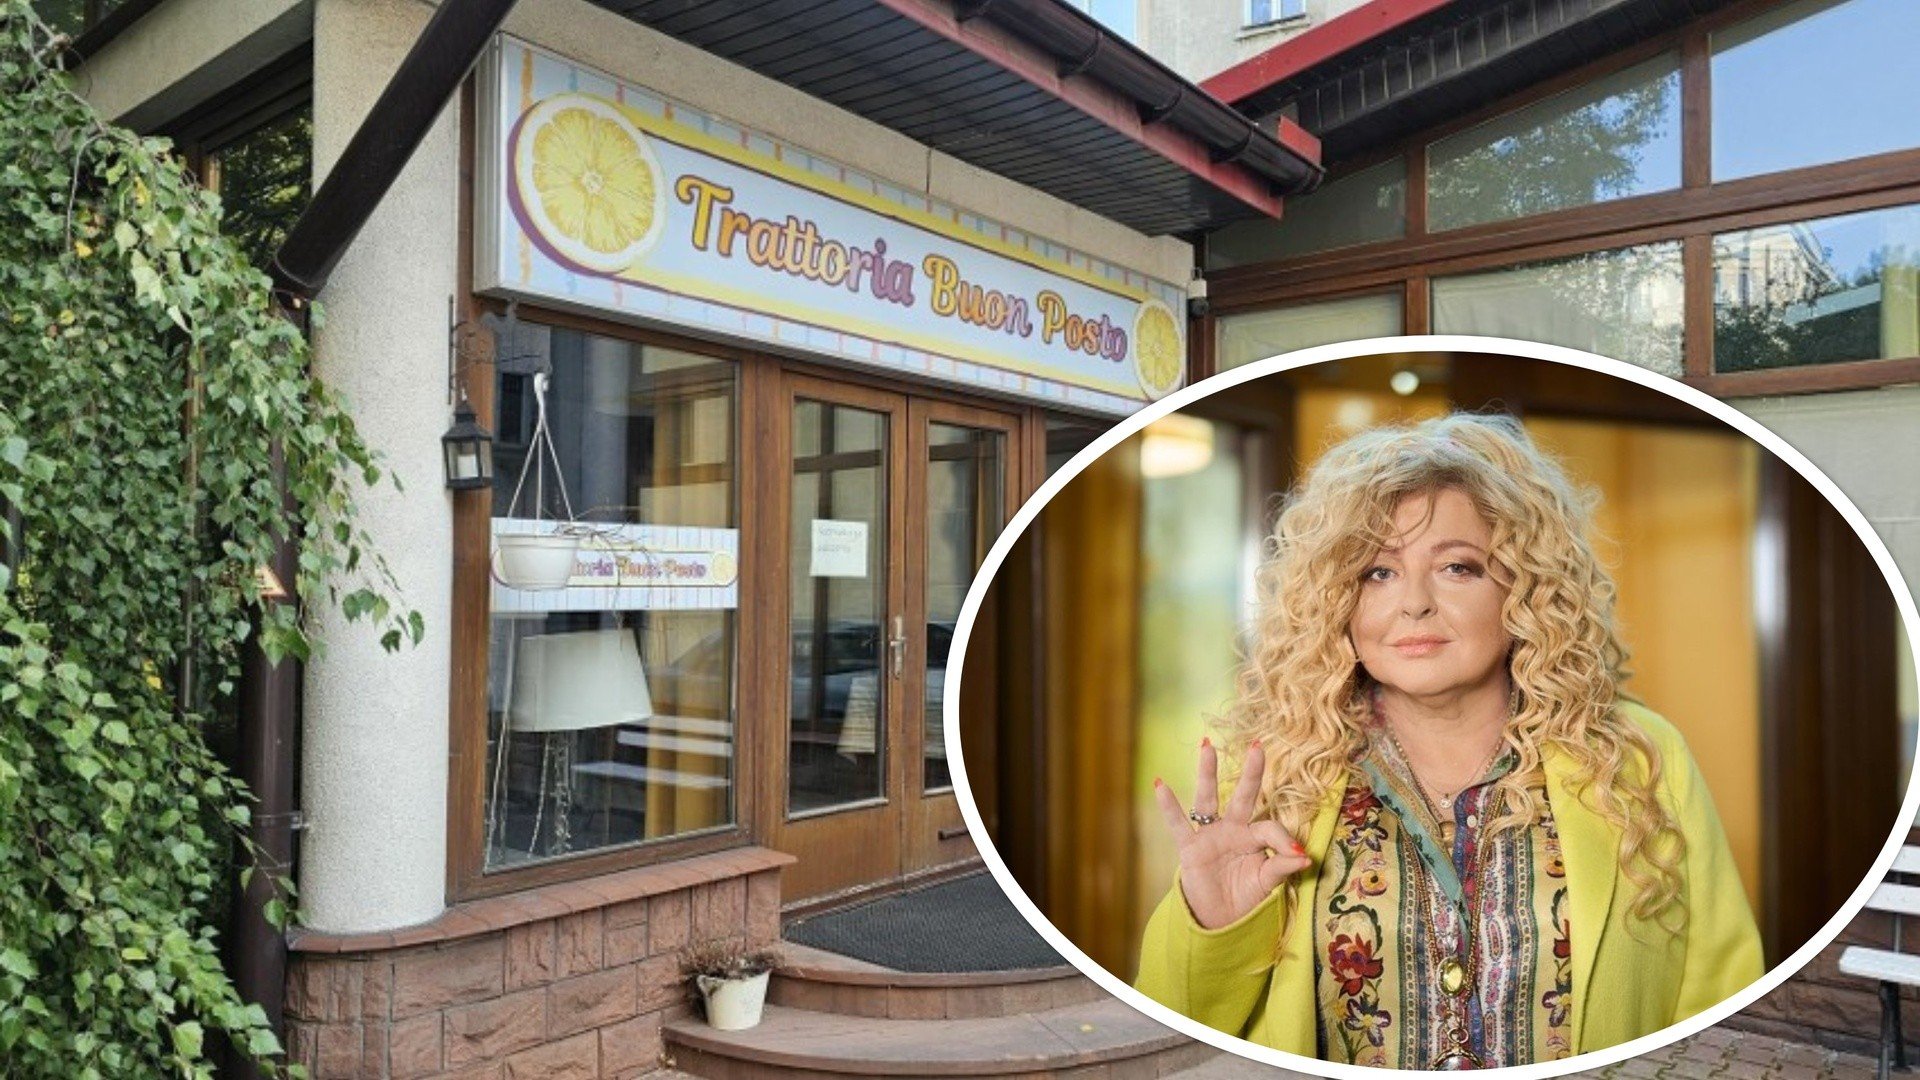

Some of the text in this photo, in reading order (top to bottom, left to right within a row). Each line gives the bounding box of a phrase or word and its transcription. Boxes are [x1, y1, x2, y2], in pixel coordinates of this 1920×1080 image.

[674, 174, 1129, 362] Trattoria Buon Posto
